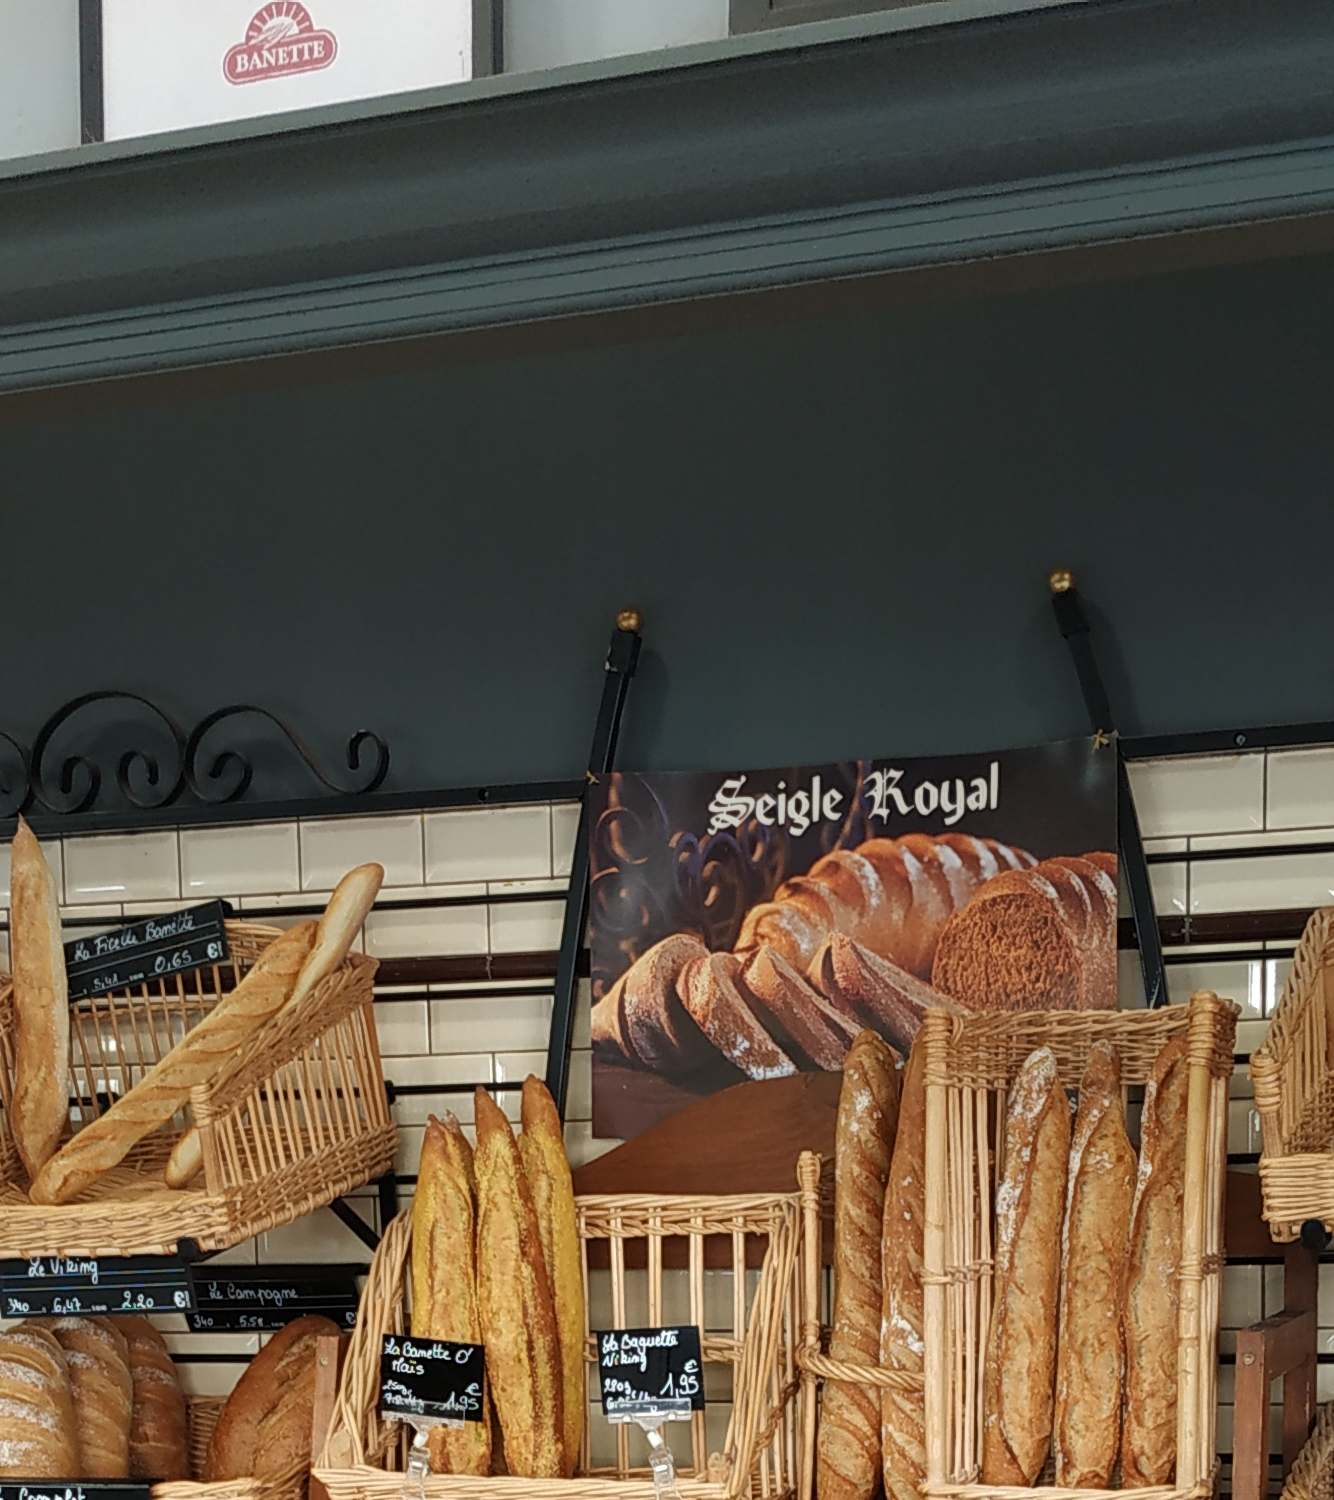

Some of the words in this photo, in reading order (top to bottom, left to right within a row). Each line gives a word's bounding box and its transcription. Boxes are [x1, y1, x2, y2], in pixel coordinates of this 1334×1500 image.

[236, 40, 325, 73] BANETTE
[707, 775, 843, 836] Seigle
[865, 761, 999, 825] Royal
[145, 911, 197, 941] Banette
[154, 949, 192, 973] 0,65
[49, 1257, 99, 1284] Viking
[122, 1291, 154, 1309] 2,20
[174, 1291, 186, 1308] €
[403, 1341, 451, 1360] Banette
[620, 1330, 679, 1371] Baguette
[392, 1357, 424, 1375] Maïs
[660, 1372, 699, 1398] 1,95
